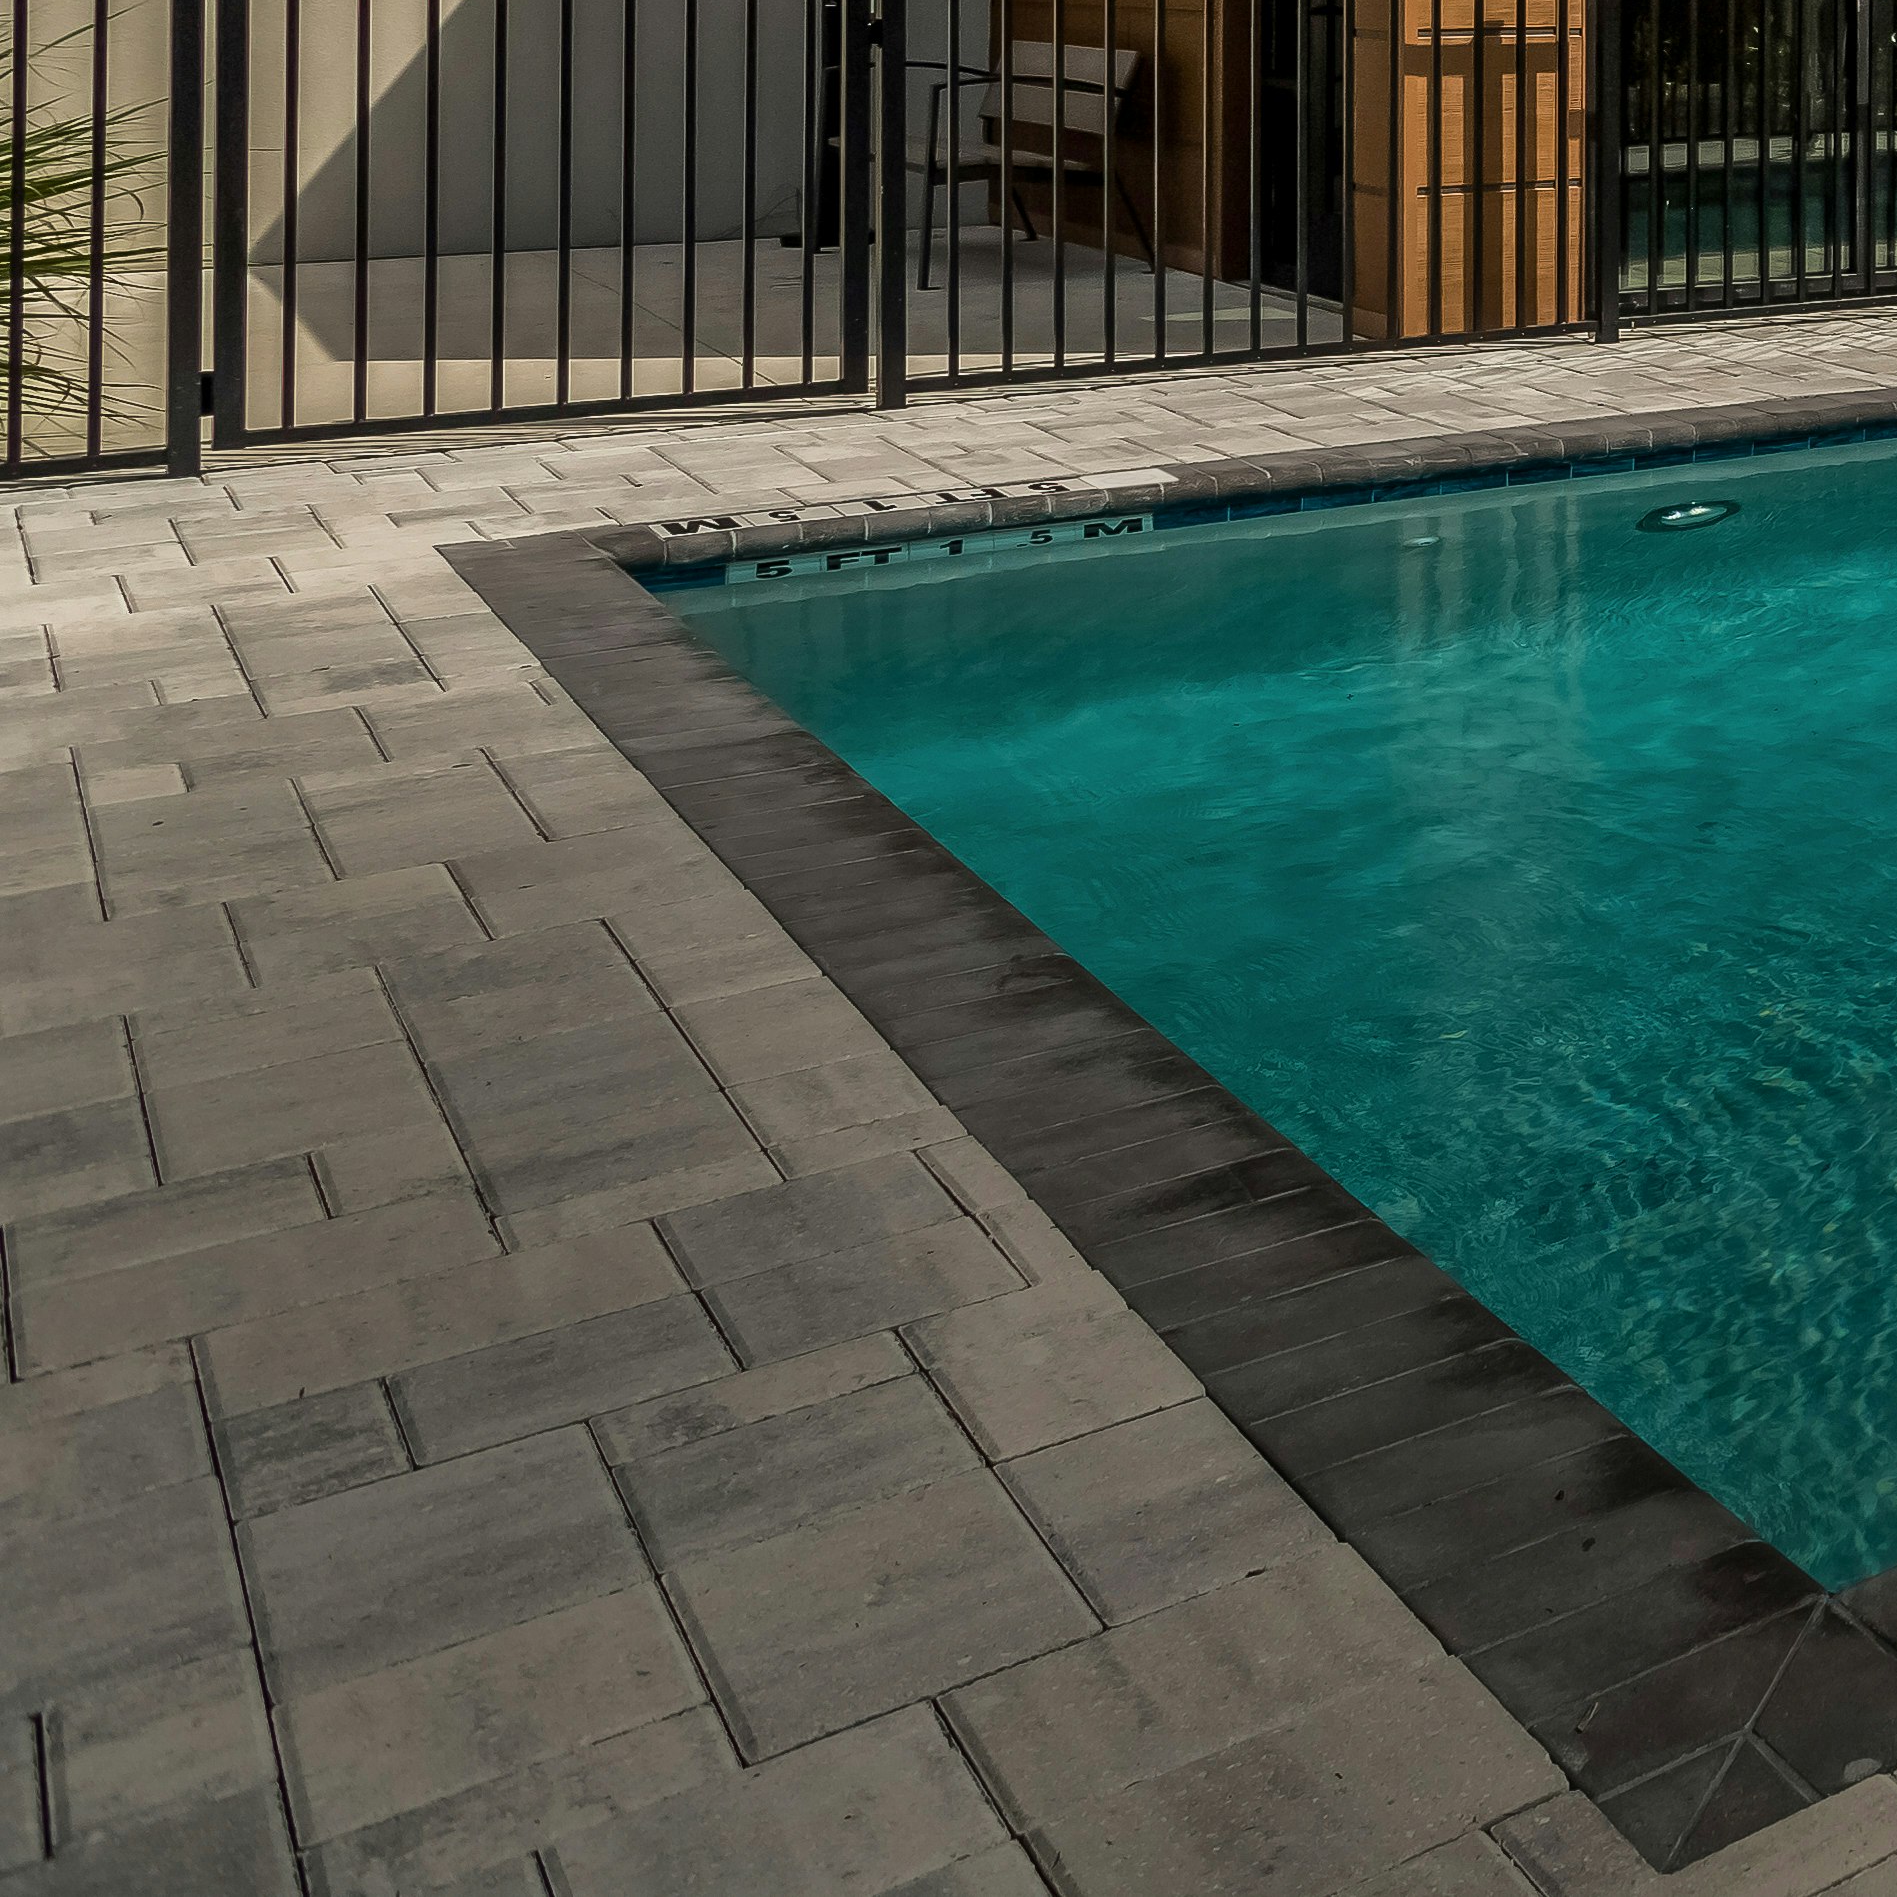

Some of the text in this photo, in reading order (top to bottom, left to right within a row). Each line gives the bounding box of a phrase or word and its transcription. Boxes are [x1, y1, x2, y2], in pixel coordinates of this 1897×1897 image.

[755, 558, 794, 579] 5
[826, 546, 903, 572] FT
[1083, 517, 1144, 539] M
